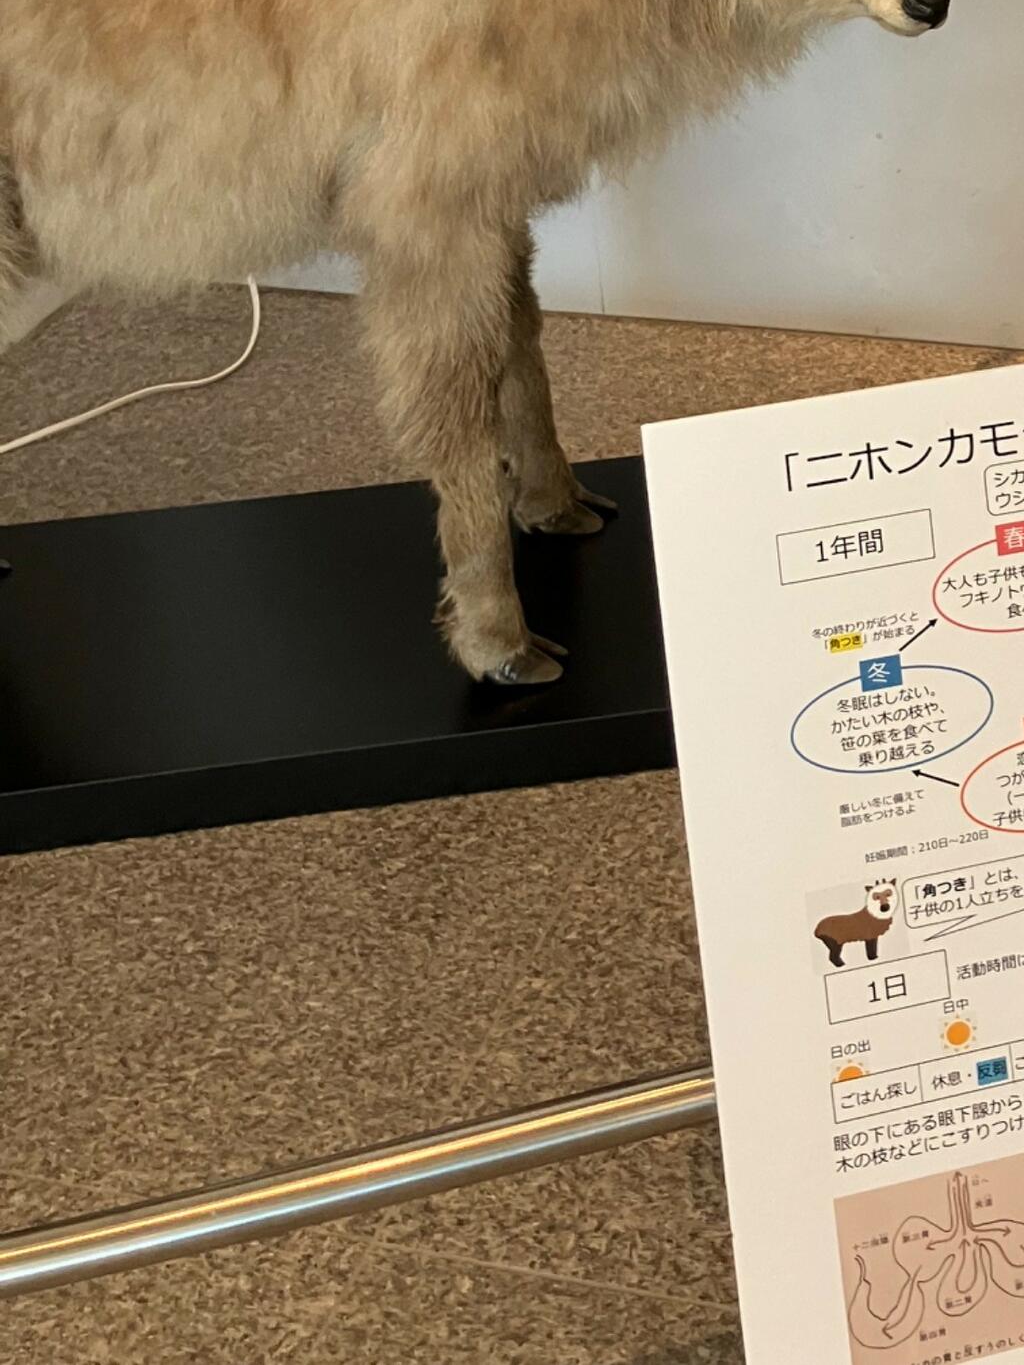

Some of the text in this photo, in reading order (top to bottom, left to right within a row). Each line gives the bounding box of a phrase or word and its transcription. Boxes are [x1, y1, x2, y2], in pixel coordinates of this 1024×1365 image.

[815, 528, 884, 563] 1年間
[812, 610, 920, 639] 冬の終わりが近づくと
[823, 625, 915, 651] 「角つき」が始まる
[867, 662, 890, 683] 冬
[836, 686, 937, 714] 冬眠はしない。
[831, 702, 945, 735] かたい木の枝や、
[840, 719, 948, 752] 笹の葉を食べて
[858, 739, 935, 767] 乗り越える
[839, 789, 925, 815] 厳しい冬に備えて
[840, 804, 916, 828] 脂肪をつけるよ
[866, 973, 907, 1004] 1日
[943, 998, 969, 1014] 日中
[830, 1039, 871, 1059] 日の出
[840, 1081, 917, 1109] ごはん探し
